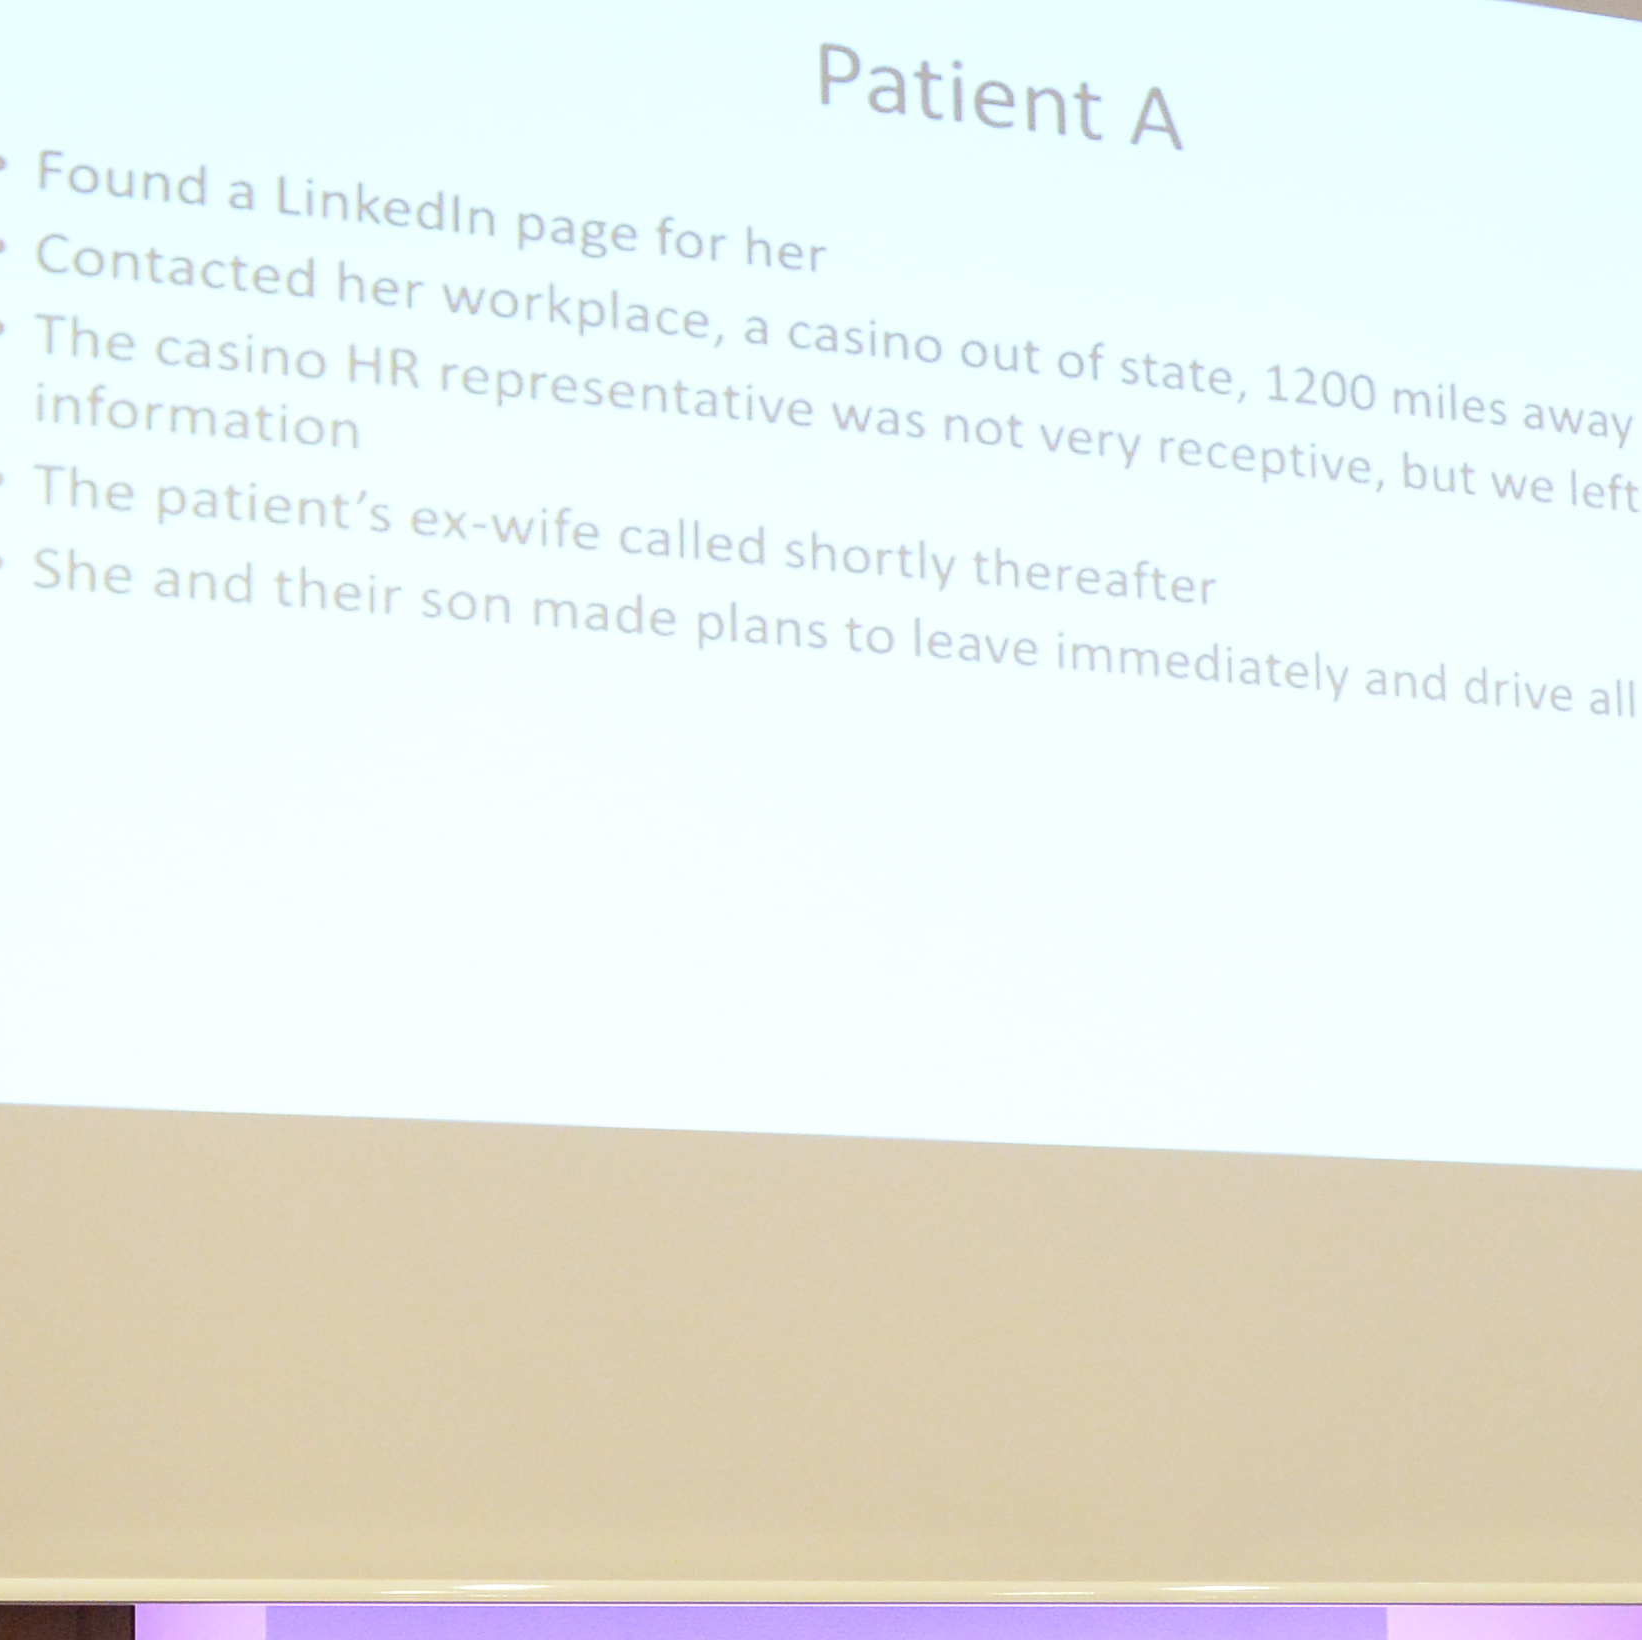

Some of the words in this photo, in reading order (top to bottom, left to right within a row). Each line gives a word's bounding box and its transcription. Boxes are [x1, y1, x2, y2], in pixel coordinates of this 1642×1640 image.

[819, 42, 1103, 142] Patient
[1130, 86, 1184, 151] A
[39, 149, 207, 206] Found
[228, 180, 255, 211] a
[277, 175, 495, 236] LinkedIn
[518, 212, 638, 259] page
[656, 215, 727, 261] for
[746, 226, 827, 272] her
[36, 233, 315, 298] Contacted
[338, 260, 424, 308] her
[442, 283, 724, 348] workplace,
[744, 316, 768, 345] a
[788, 320, 943, 364] casino
[960, 339, 1040, 375] out
[1057, 341, 1104, 381] of
[1121, 354, 1246, 403] state,
[1268, 364, 1376, 411] 1200
[1393, 383, 1507, 426] miles
[1523, 403, 1633, 449] away
[35, 313, 136, 362] The
[156, 334, 326, 379] casino
[349, 344, 419, 389] HR
[441, 364, 813, 427] representative
[832, 403, 926, 439] was
[944, 414, 1023, 449] not
[1040, 424, 1141, 469] very
[1160, 437, 1384, 492] receptive,
[1402, 451, 1475, 495] but
[1491, 472, 1554, 503] we
[1571, 470, 1639, 513] left
[37, 382, 359, 449] information
[34, 464, 134, 512] The
[411, 507, 600, 551] ex-wife
[619, 518, 765, 565] called
[786, 531, 956, 591] shortly
[974, 547, 1217, 605] thereafter
[34, 548, 132, 595] She
[154, 562, 252, 603] and
[275, 566, 402, 614] their
[422, 588, 510, 624] son
[534, 594, 676, 637] made
[698, 602, 828, 650] plans
[845, 618, 895, 655] to
[914, 617, 1038, 667] leave
[1058, 632, 1349, 702] immediately
[1365, 663, 1446, 701] and
[1464, 667, 1573, 712] drive
[1590, 679, 1635, 717] all
